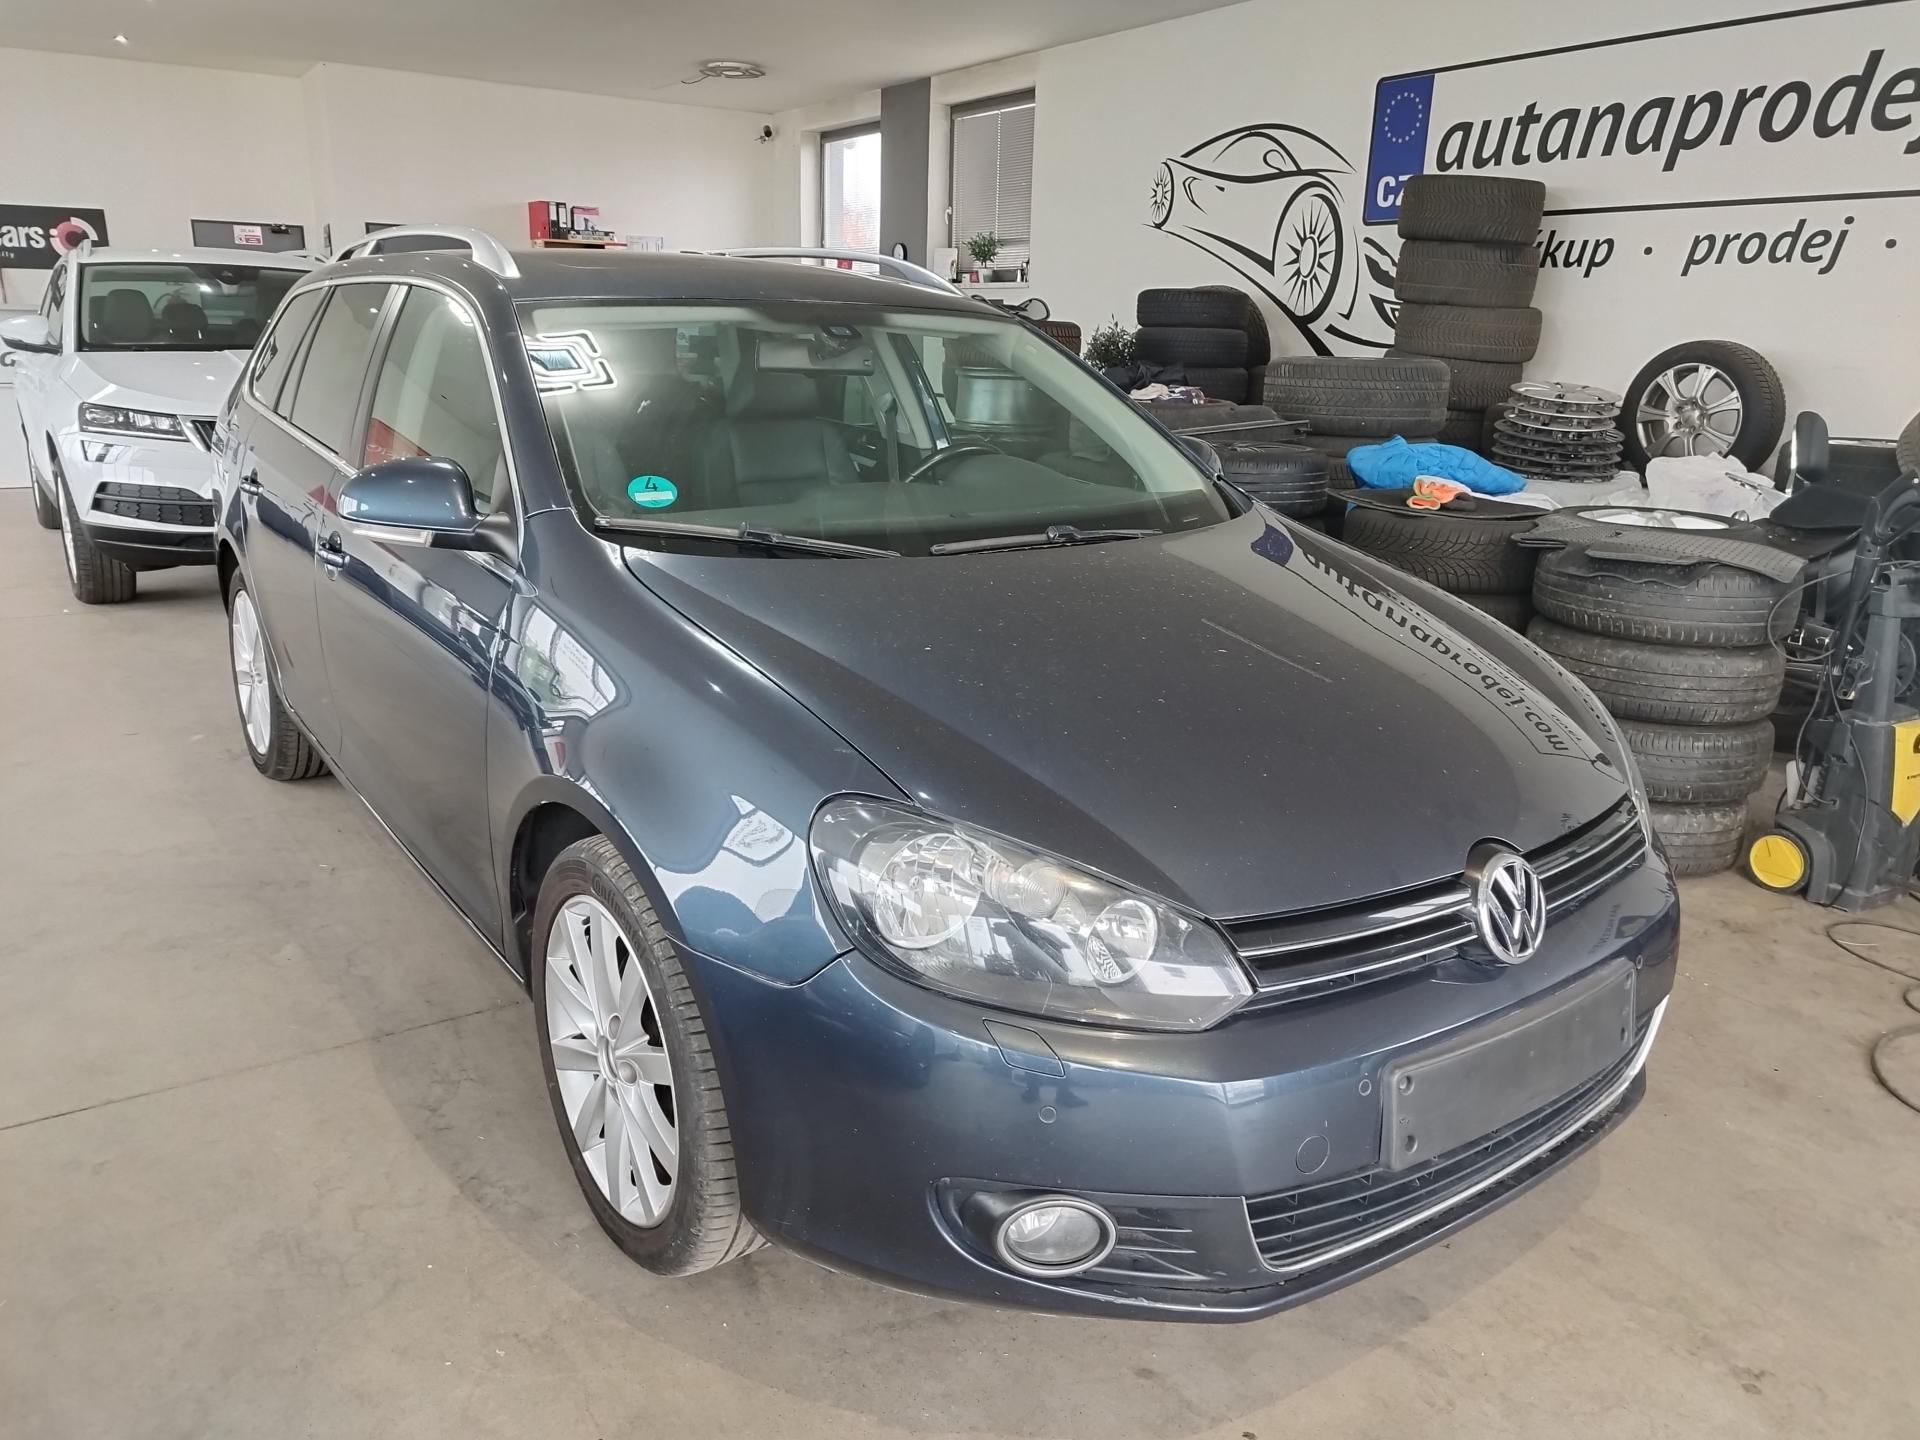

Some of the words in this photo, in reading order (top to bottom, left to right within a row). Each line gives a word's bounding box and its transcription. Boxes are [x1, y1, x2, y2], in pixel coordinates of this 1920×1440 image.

[1436, 48, 1920, 173] autanaprode
[0, 225, 46, 249] ars
[1536, 228, 1615, 279] kup
[1681, 215, 1855, 277] prodej
[645, 477, 658, 492] 4
